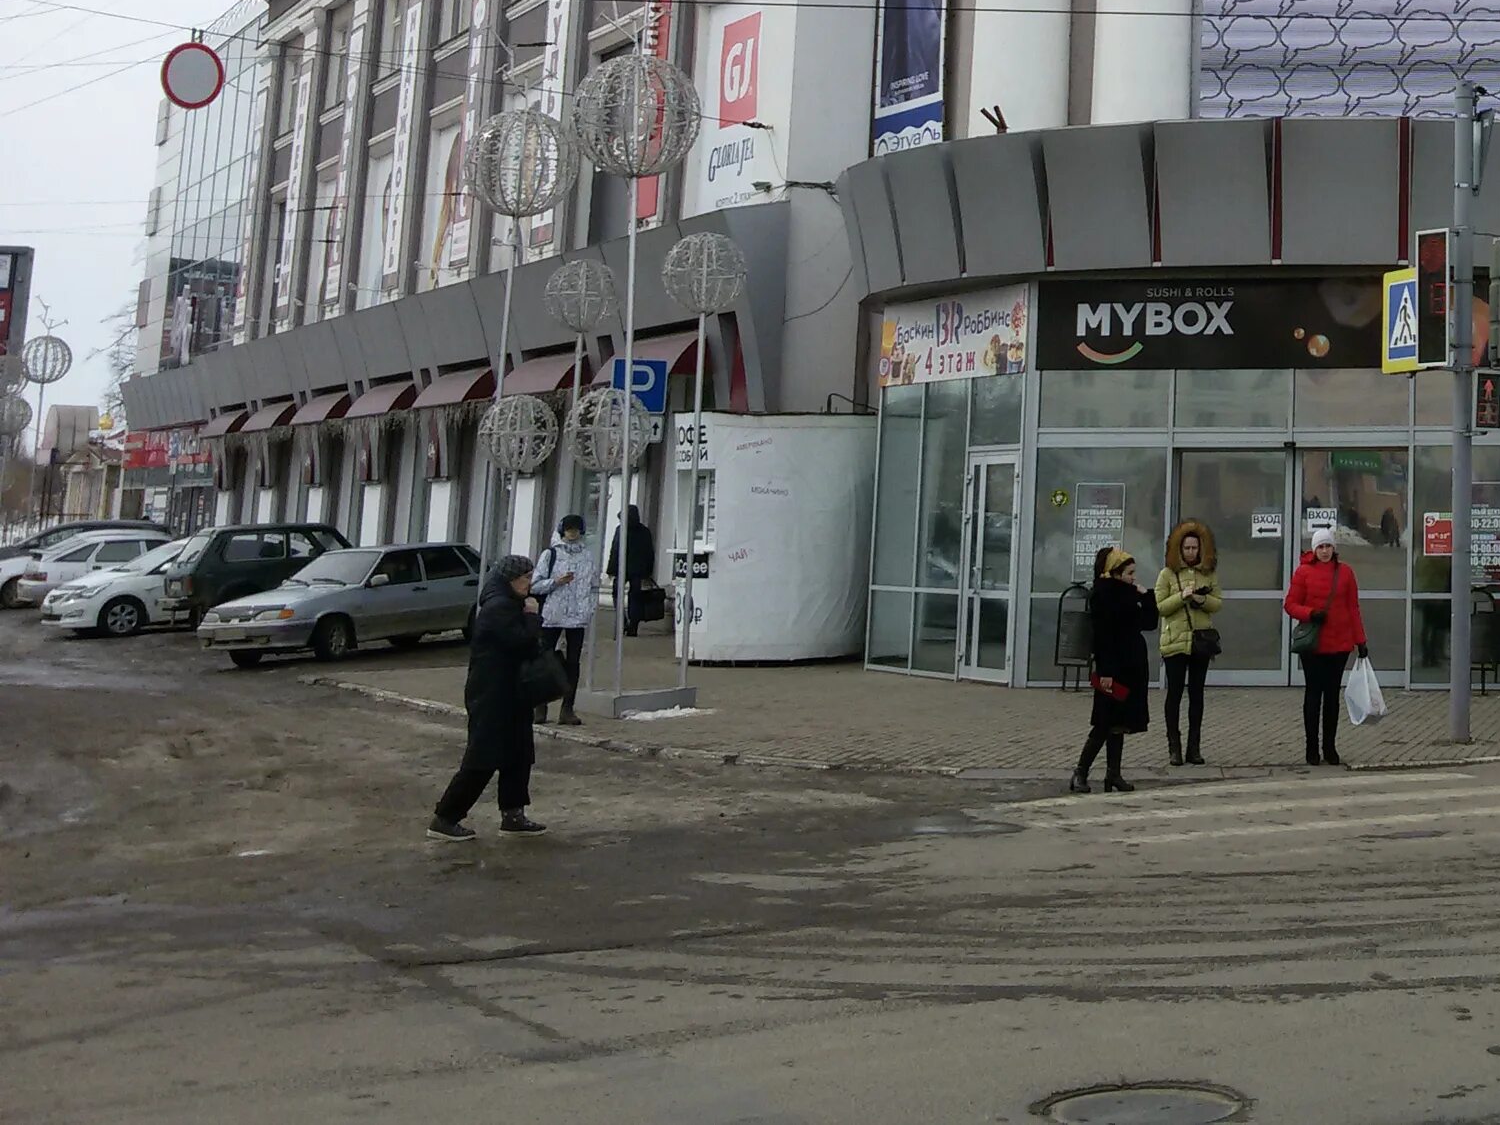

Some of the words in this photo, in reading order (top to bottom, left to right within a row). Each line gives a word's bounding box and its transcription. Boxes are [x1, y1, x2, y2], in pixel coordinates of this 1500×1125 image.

[724, 38, 755, 103] GJ
[708, 142, 740, 183] GLORIA
[737, 136, 754, 176] JEA
[1146, 287, 1181, 298] SUSHI
[1184, 287, 1193, 297] &
[1195, 286, 1235, 297] ROLLS
[1076, 301, 1235, 337] MYBOX
[925, 347, 933, 375] 4
[939, 350, 976, 374] этаж
[677, 424, 708, 446] ОФЕ
[1253, 515, 1281, 524] ВХОД
[1308, 510, 1337, 520] ВХОД
